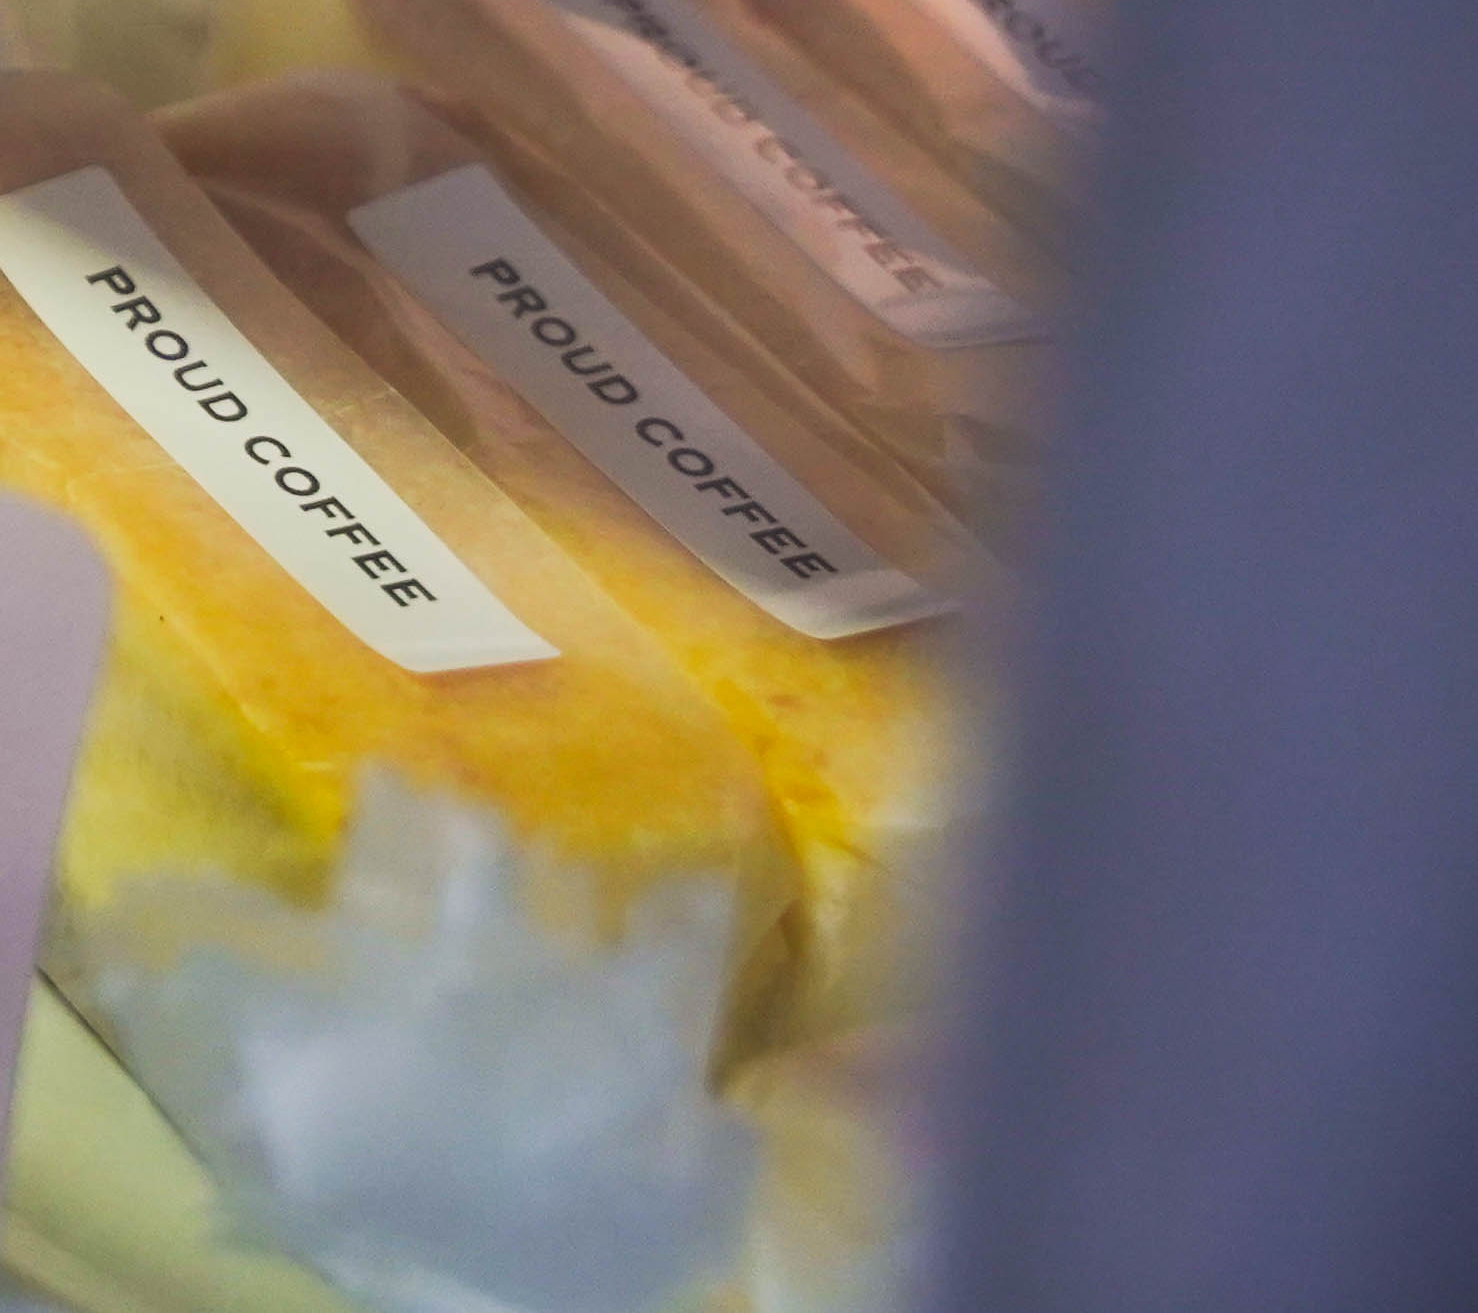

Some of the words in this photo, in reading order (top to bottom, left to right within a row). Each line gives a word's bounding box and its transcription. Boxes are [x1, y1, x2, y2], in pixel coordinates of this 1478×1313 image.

[754, 133, 946, 294] COFFEE
[84, 263, 249, 423] PROUD
[243, 434, 439, 608] COFFEE
[469, 256, 640, 406] PROUD
[634, 416, 840, 580] COFFEE
